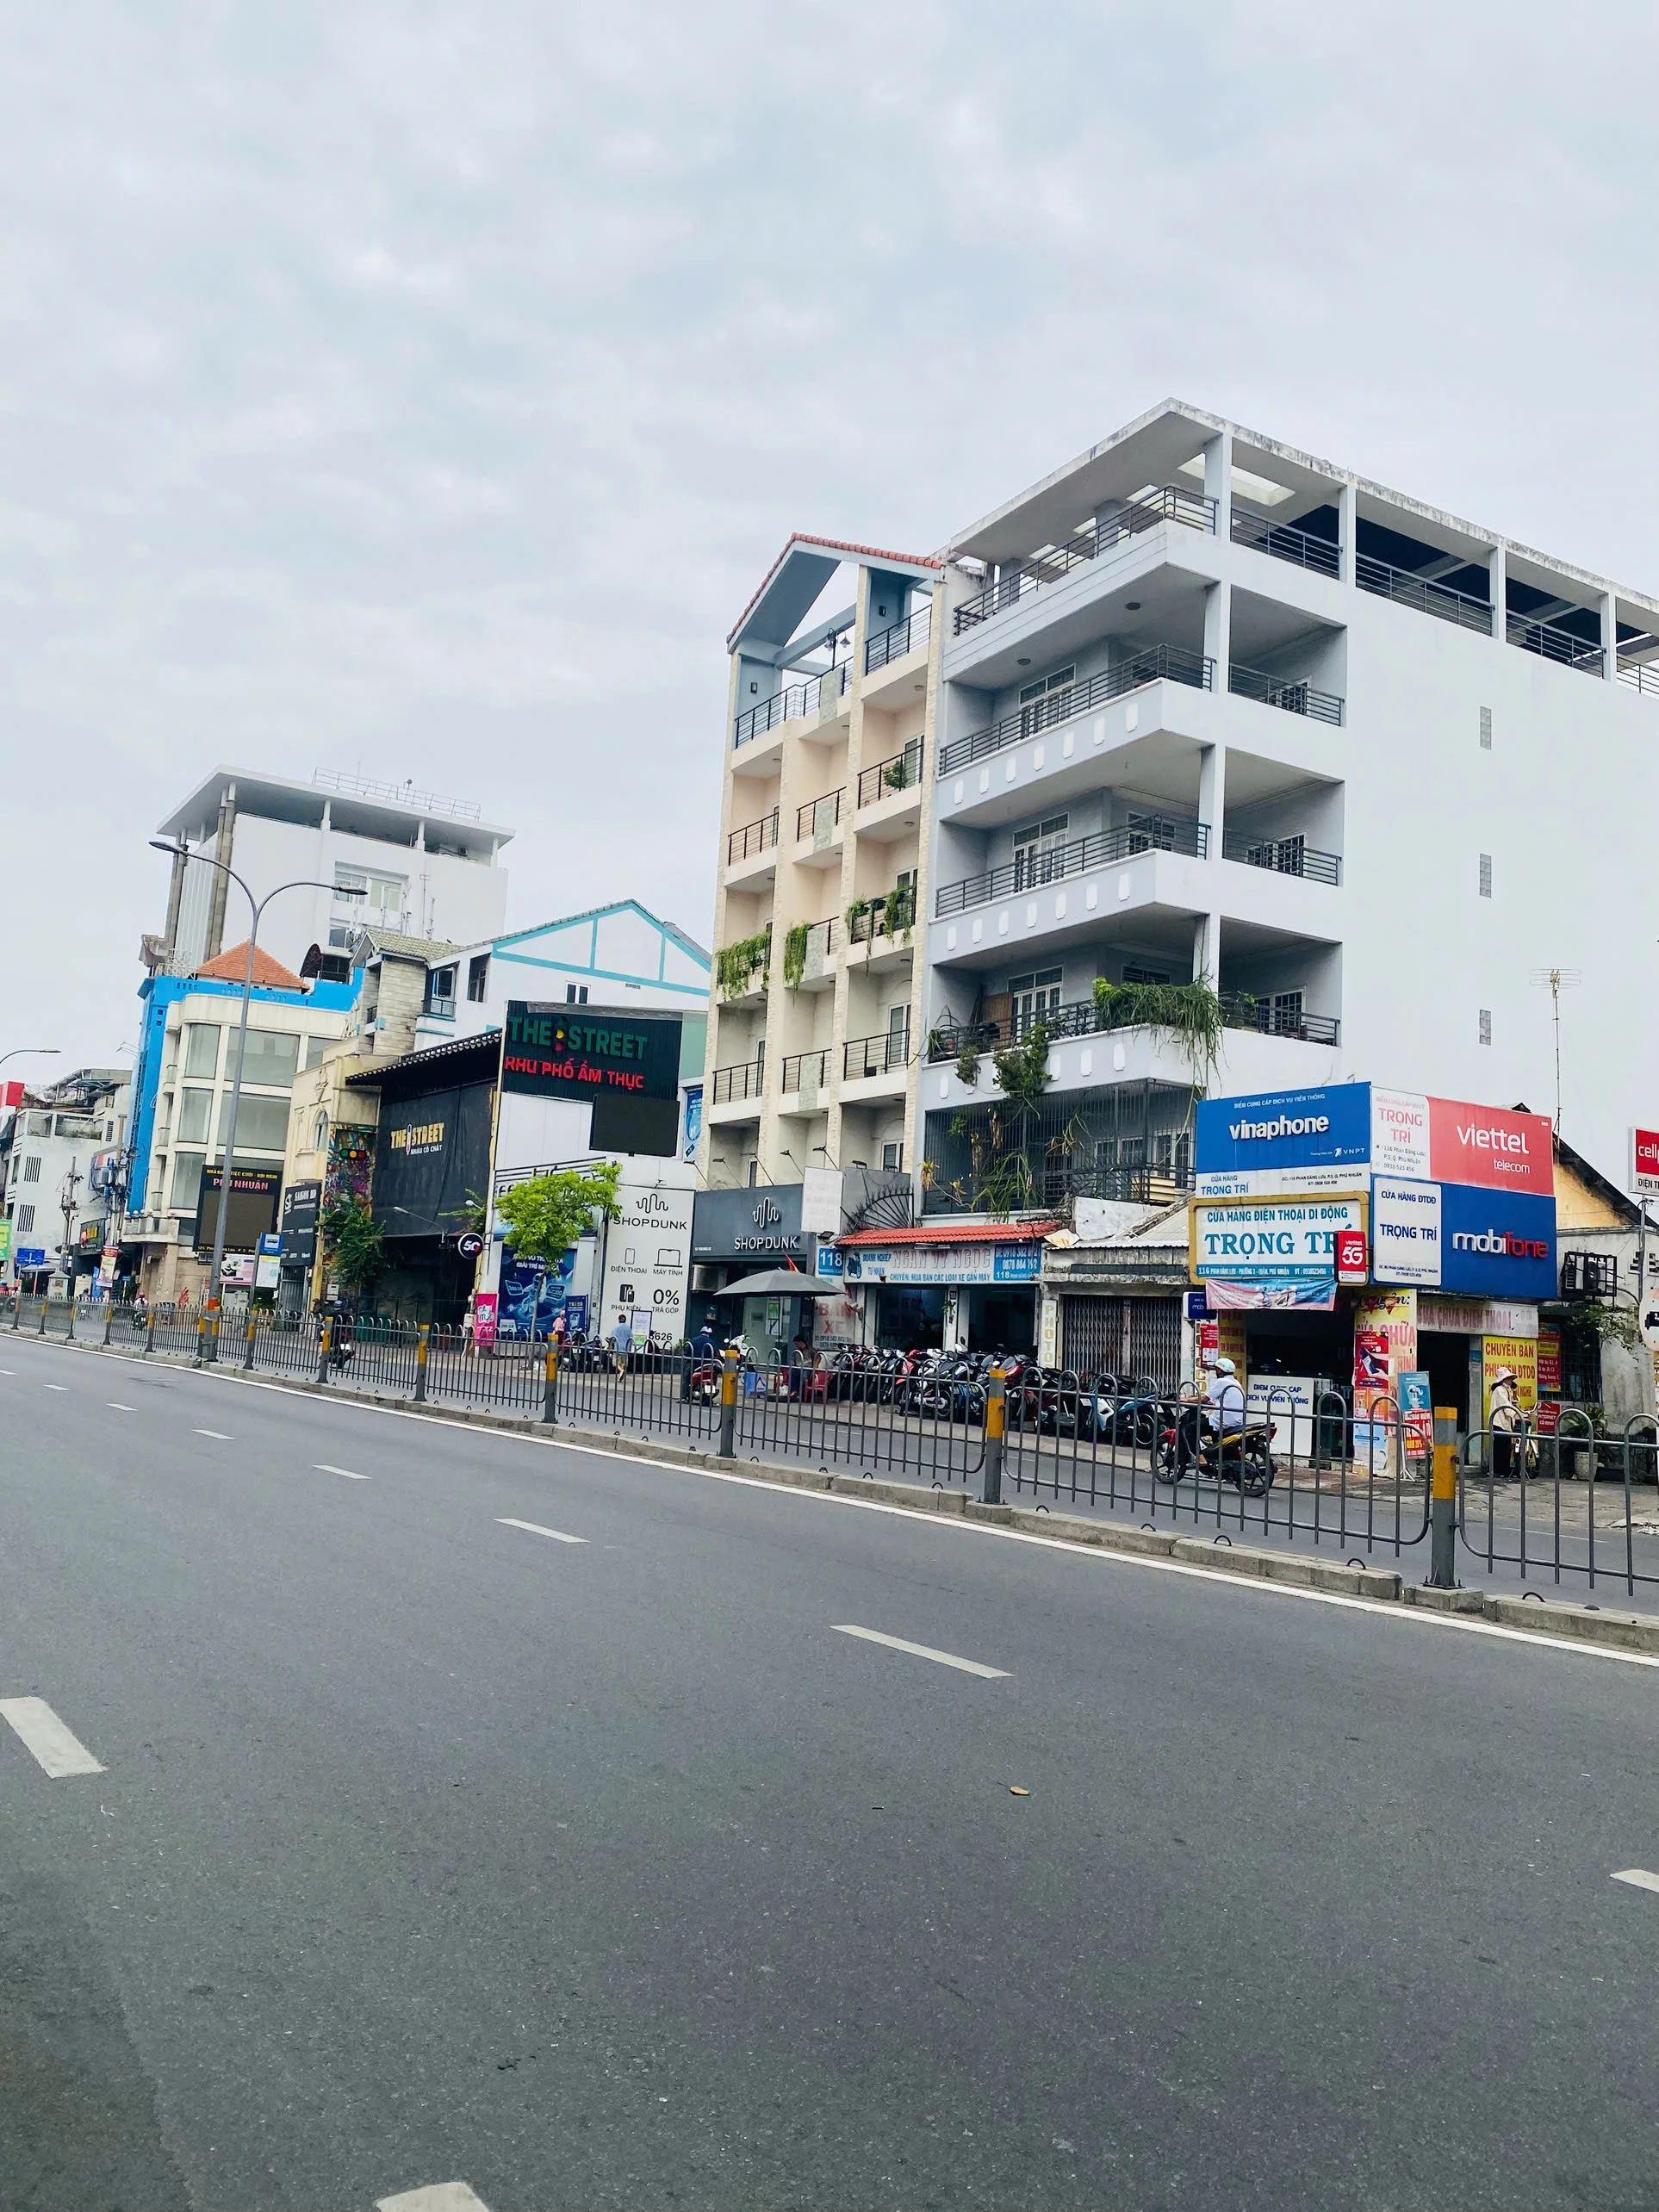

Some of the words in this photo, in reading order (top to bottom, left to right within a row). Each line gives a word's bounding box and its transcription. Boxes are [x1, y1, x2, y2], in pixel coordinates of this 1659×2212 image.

[506, 1016, 552, 1046] THE
[568, 1025, 648, 1060] STREET
[542, 1057, 575, 1079] PHỐ
[578, 1059, 602, 1083] ẨM
[607, 1071, 643, 1091] THỰC
[1378, 1108, 1422, 1127] TRỌNG
[391, 1129, 407, 1149] THE
[412, 1122, 444, 1146] STREET
[1229, 1115, 1329, 1140] vinaphone
[1391, 1127, 1411, 1144] TRÍ
[1456, 1123, 1530, 1154] viettel
[1494, 1159, 1531, 1174] telecom
[1201, 1185, 1232, 1196] TRỌNG
[1235, 1182, 1249, 1194] TRÍ
[1382, 1190, 1395, 1200] CỬA
[1398, 1190, 1416, 1202] HÀNG
[612, 1216, 687, 1230] SHOPDUNK
[1208, 1208, 1224, 1222] CỬA
[1227, 1208, 1251, 1221] HÀNG
[1254, 1208, 1275, 1224] ĐIỆN
[1278, 1209, 1306, 1223] THOẠI
[1308, 1209, 1318, 1220] DI
[1320, 1206, 1348, 1221] ĐỘNG
[1380, 1223, 1417, 1240] TRỌNG
[1420, 1227, 1437, 1240] TRÍ
[463, 1240, 481, 1252] 5G
[734, 1236, 798, 1250] SHOPDUNK
[1204, 1232, 1295, 1259] TRỌNG
[1452, 1229, 1549, 1258] mobifone
[820, 1251, 842, 1267] 118
[1342, 1246, 1363, 1264] 5G
[996, 1271, 1010, 1279] 118
[653, 1289, 680, 1305] 0%
[1044, 1305, 1054, 1368] PHOTO
[1485, 1341, 1516, 1357] CHUYÊN
[1519, 1341, 1533, 1358] BÁN
